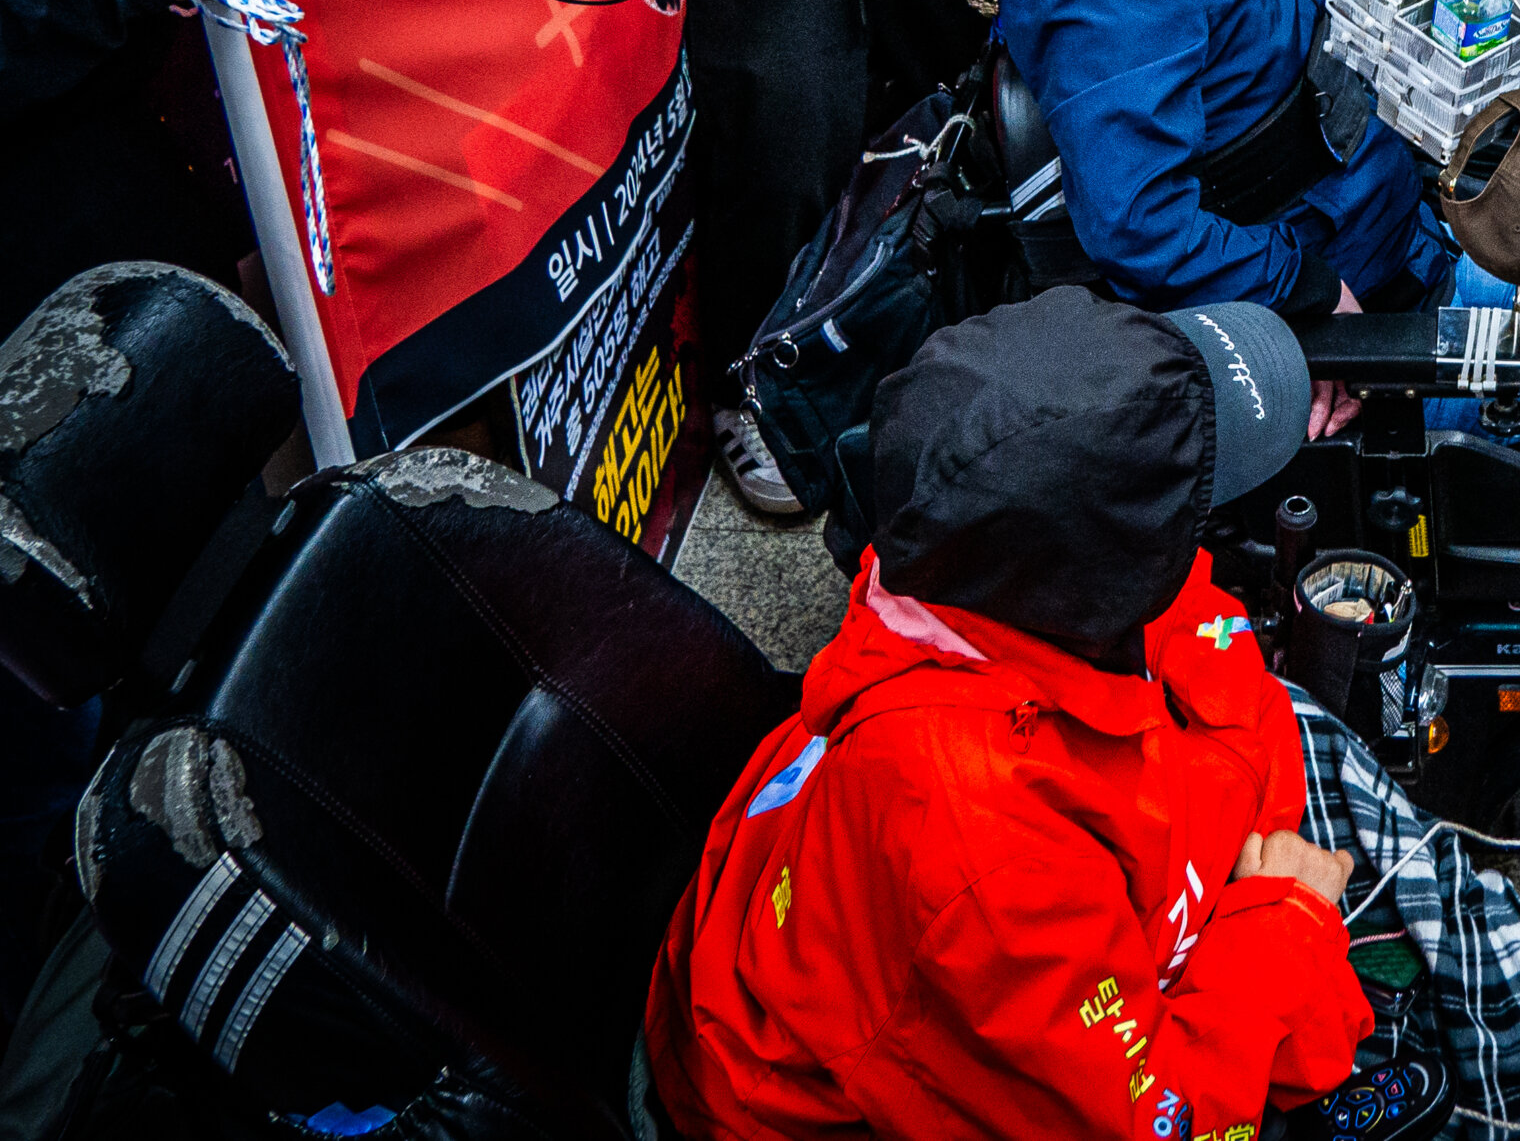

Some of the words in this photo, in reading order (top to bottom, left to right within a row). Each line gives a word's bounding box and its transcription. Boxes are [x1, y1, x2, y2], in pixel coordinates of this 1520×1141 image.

[548, 215, 603, 302] 일시
[614, 113, 665, 227] 2024년
[566, 398, 583, 456] 총
[583, 289, 629, 414] 505명
[632, 227, 661, 308] 해고
[593, 345, 660, 523] 해고는
[616, 362, 685, 545] 인이다!
